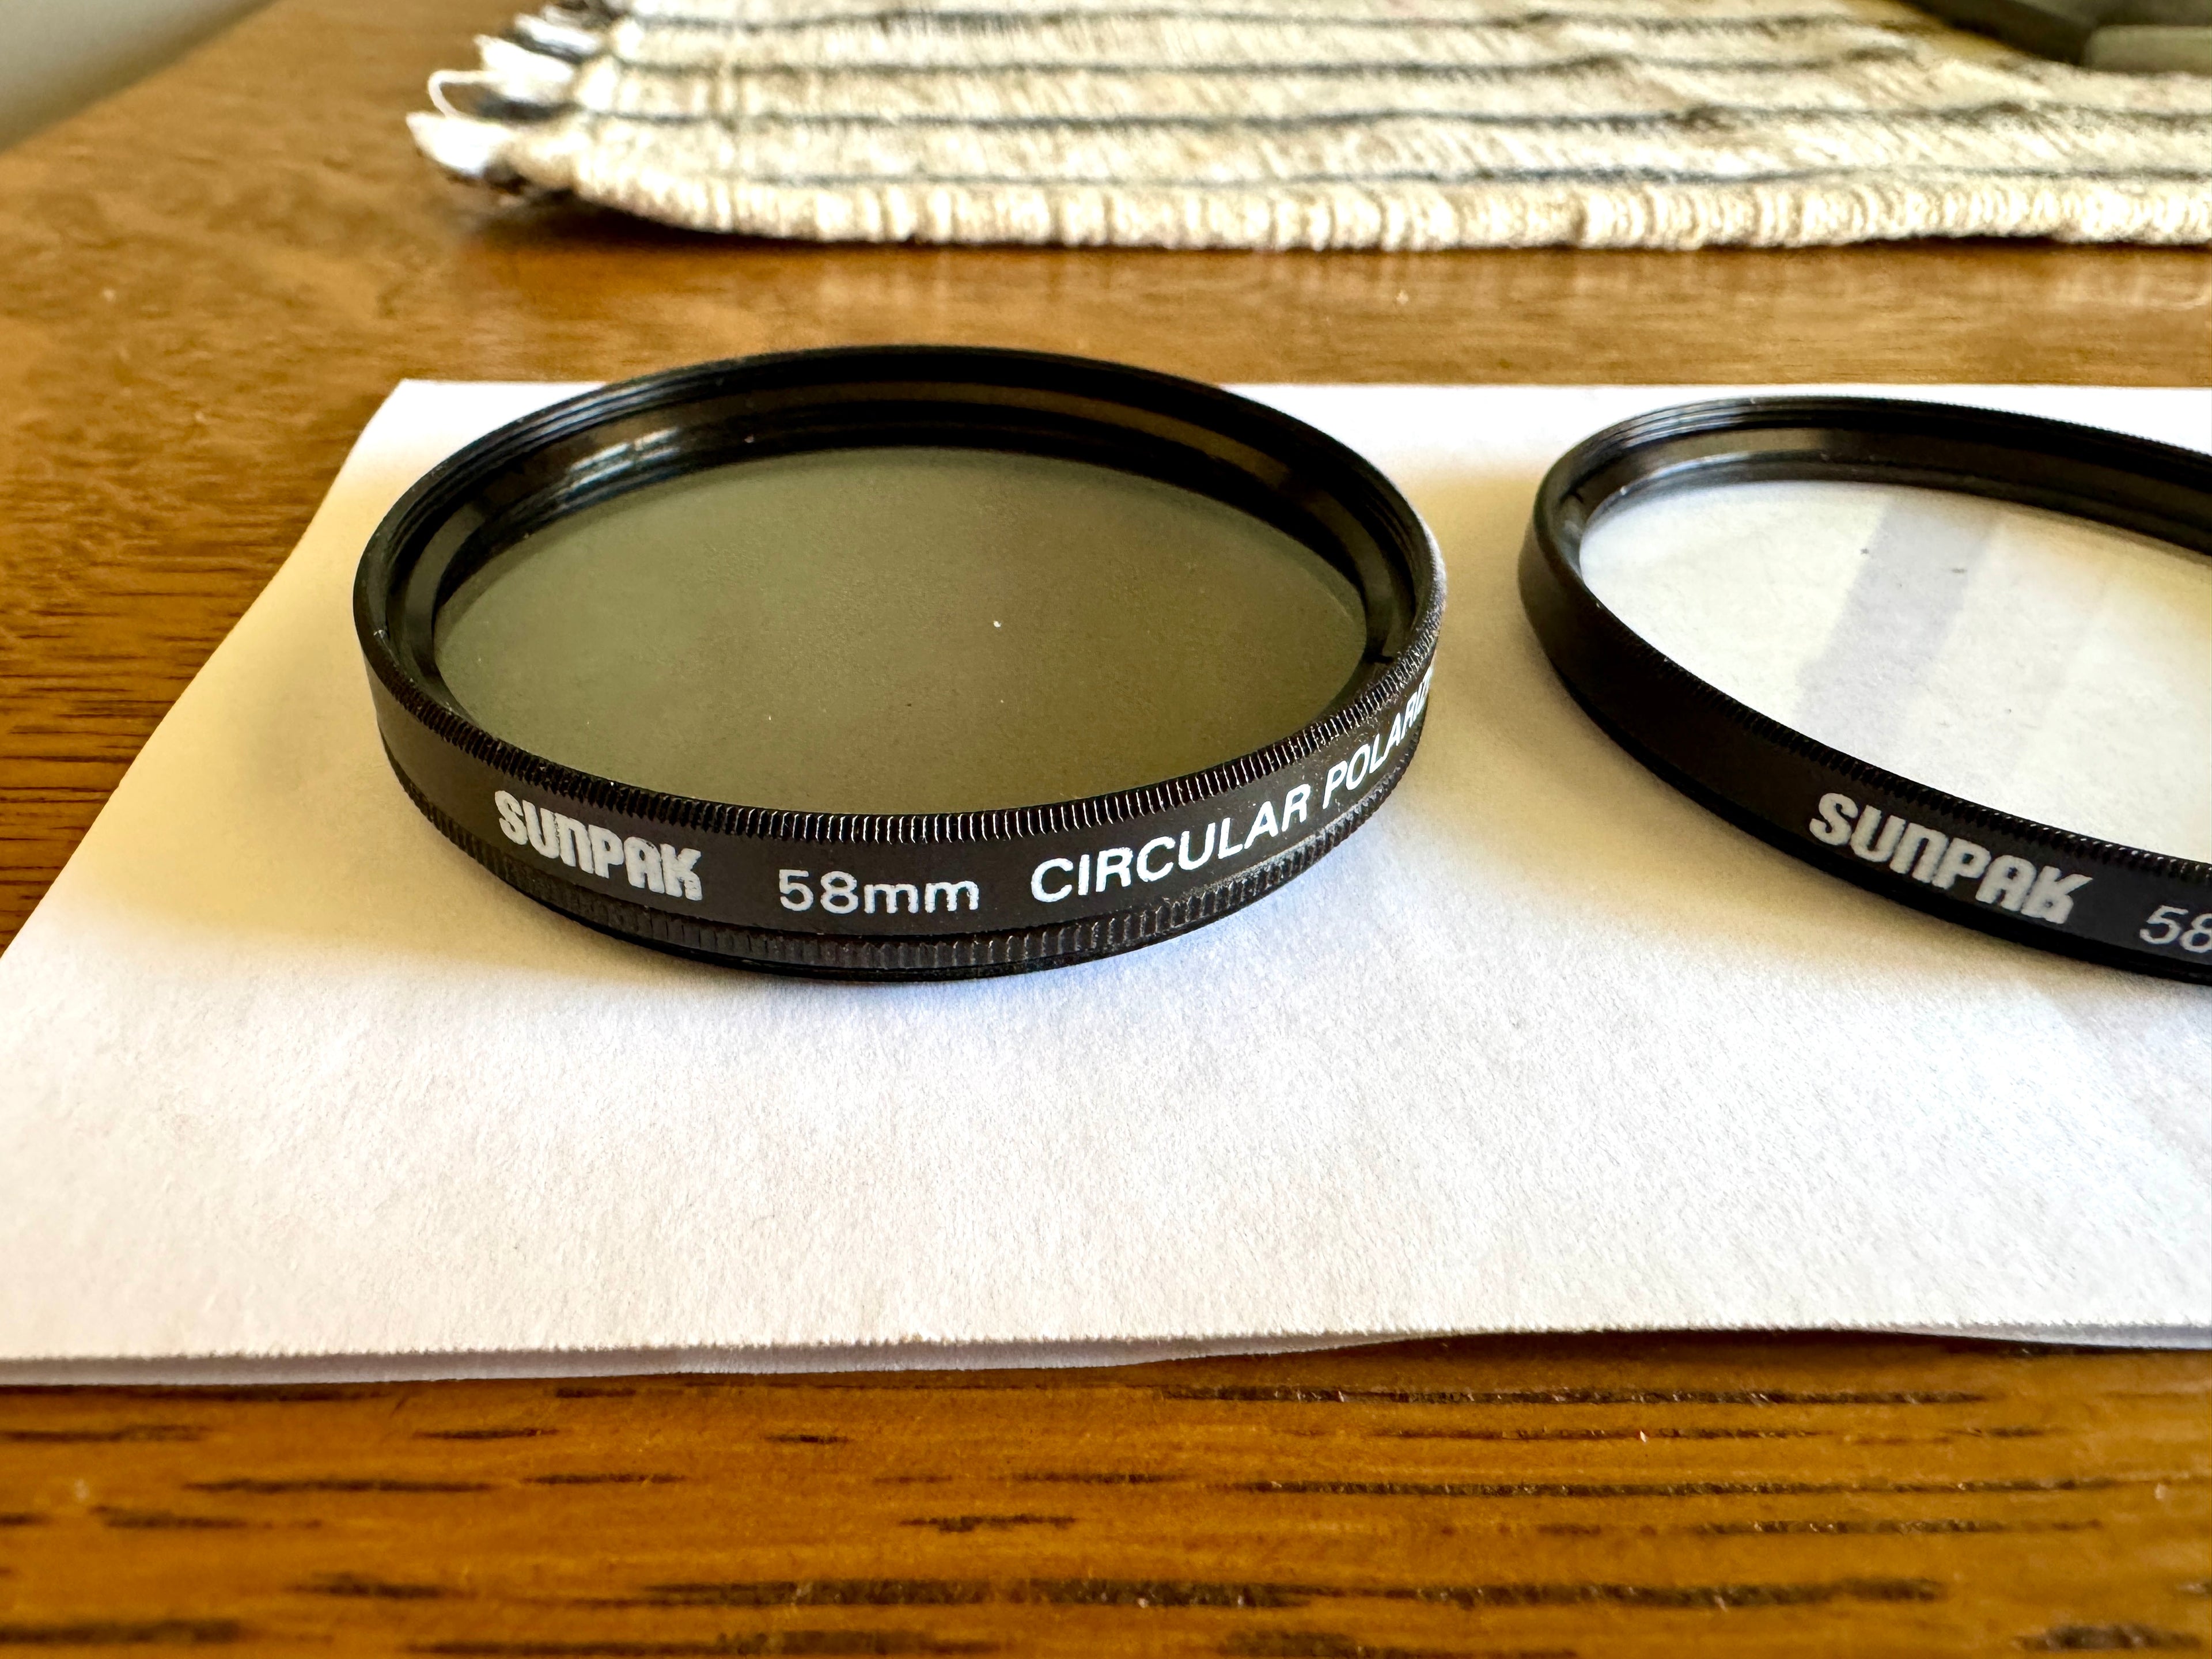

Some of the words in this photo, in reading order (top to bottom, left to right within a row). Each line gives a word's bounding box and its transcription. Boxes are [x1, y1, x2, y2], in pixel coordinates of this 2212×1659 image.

[494, 790, 703, 901] SUNPAK
[778, 869, 980, 914] 58mm
[1030, 783, 1311, 903] CIRCULAR
[1809, 793, 2093, 925] SUNPAK
[2139, 904, 2212, 953] 58
